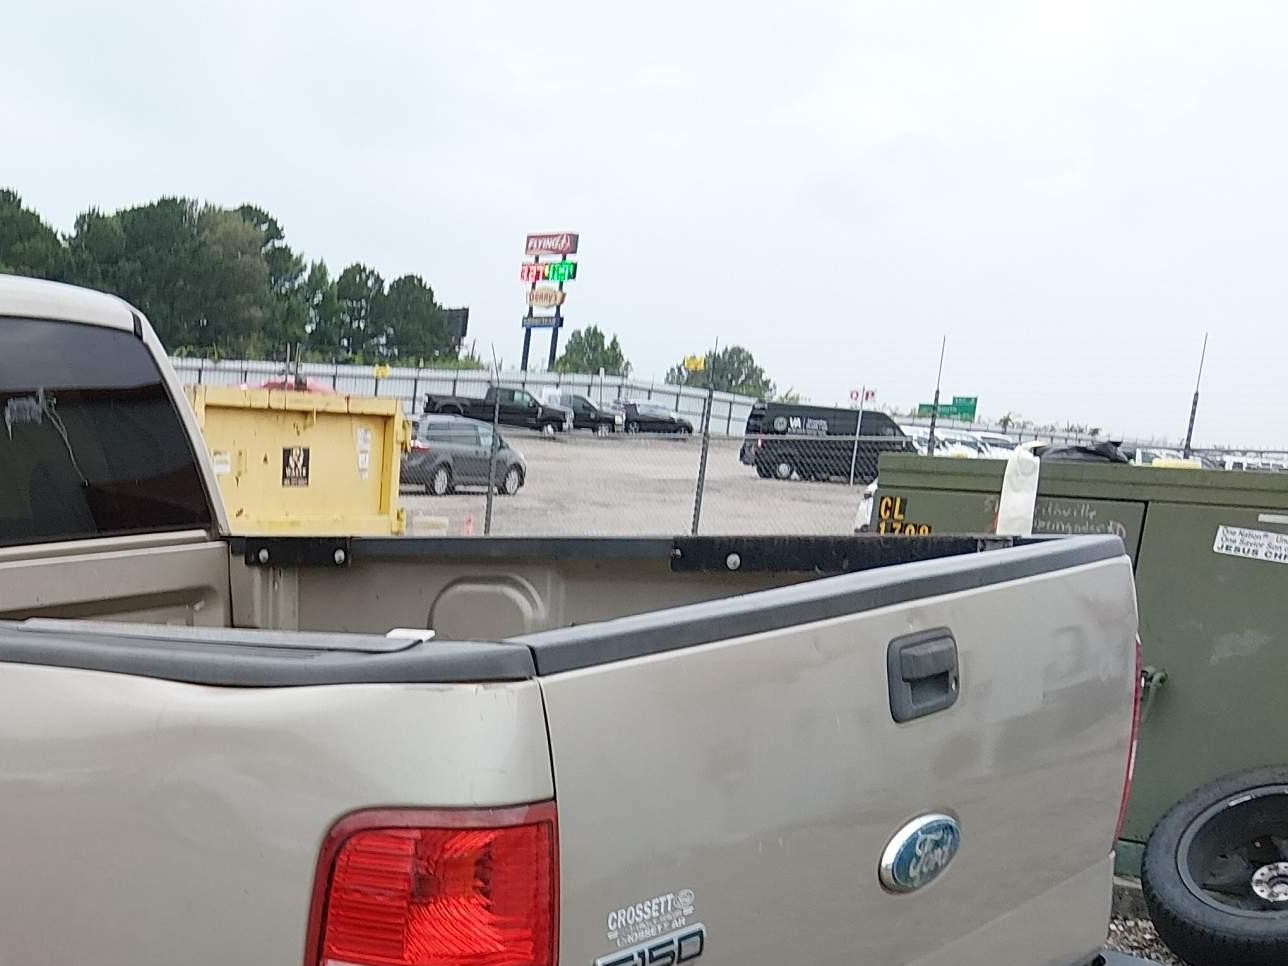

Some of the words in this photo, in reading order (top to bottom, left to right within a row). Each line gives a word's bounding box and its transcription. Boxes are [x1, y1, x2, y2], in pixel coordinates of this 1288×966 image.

[880, 496, 904, 520] CL
[1217, 544, 1259, 557] JESUS
[607, 893, 675, 931] CROSSETT
